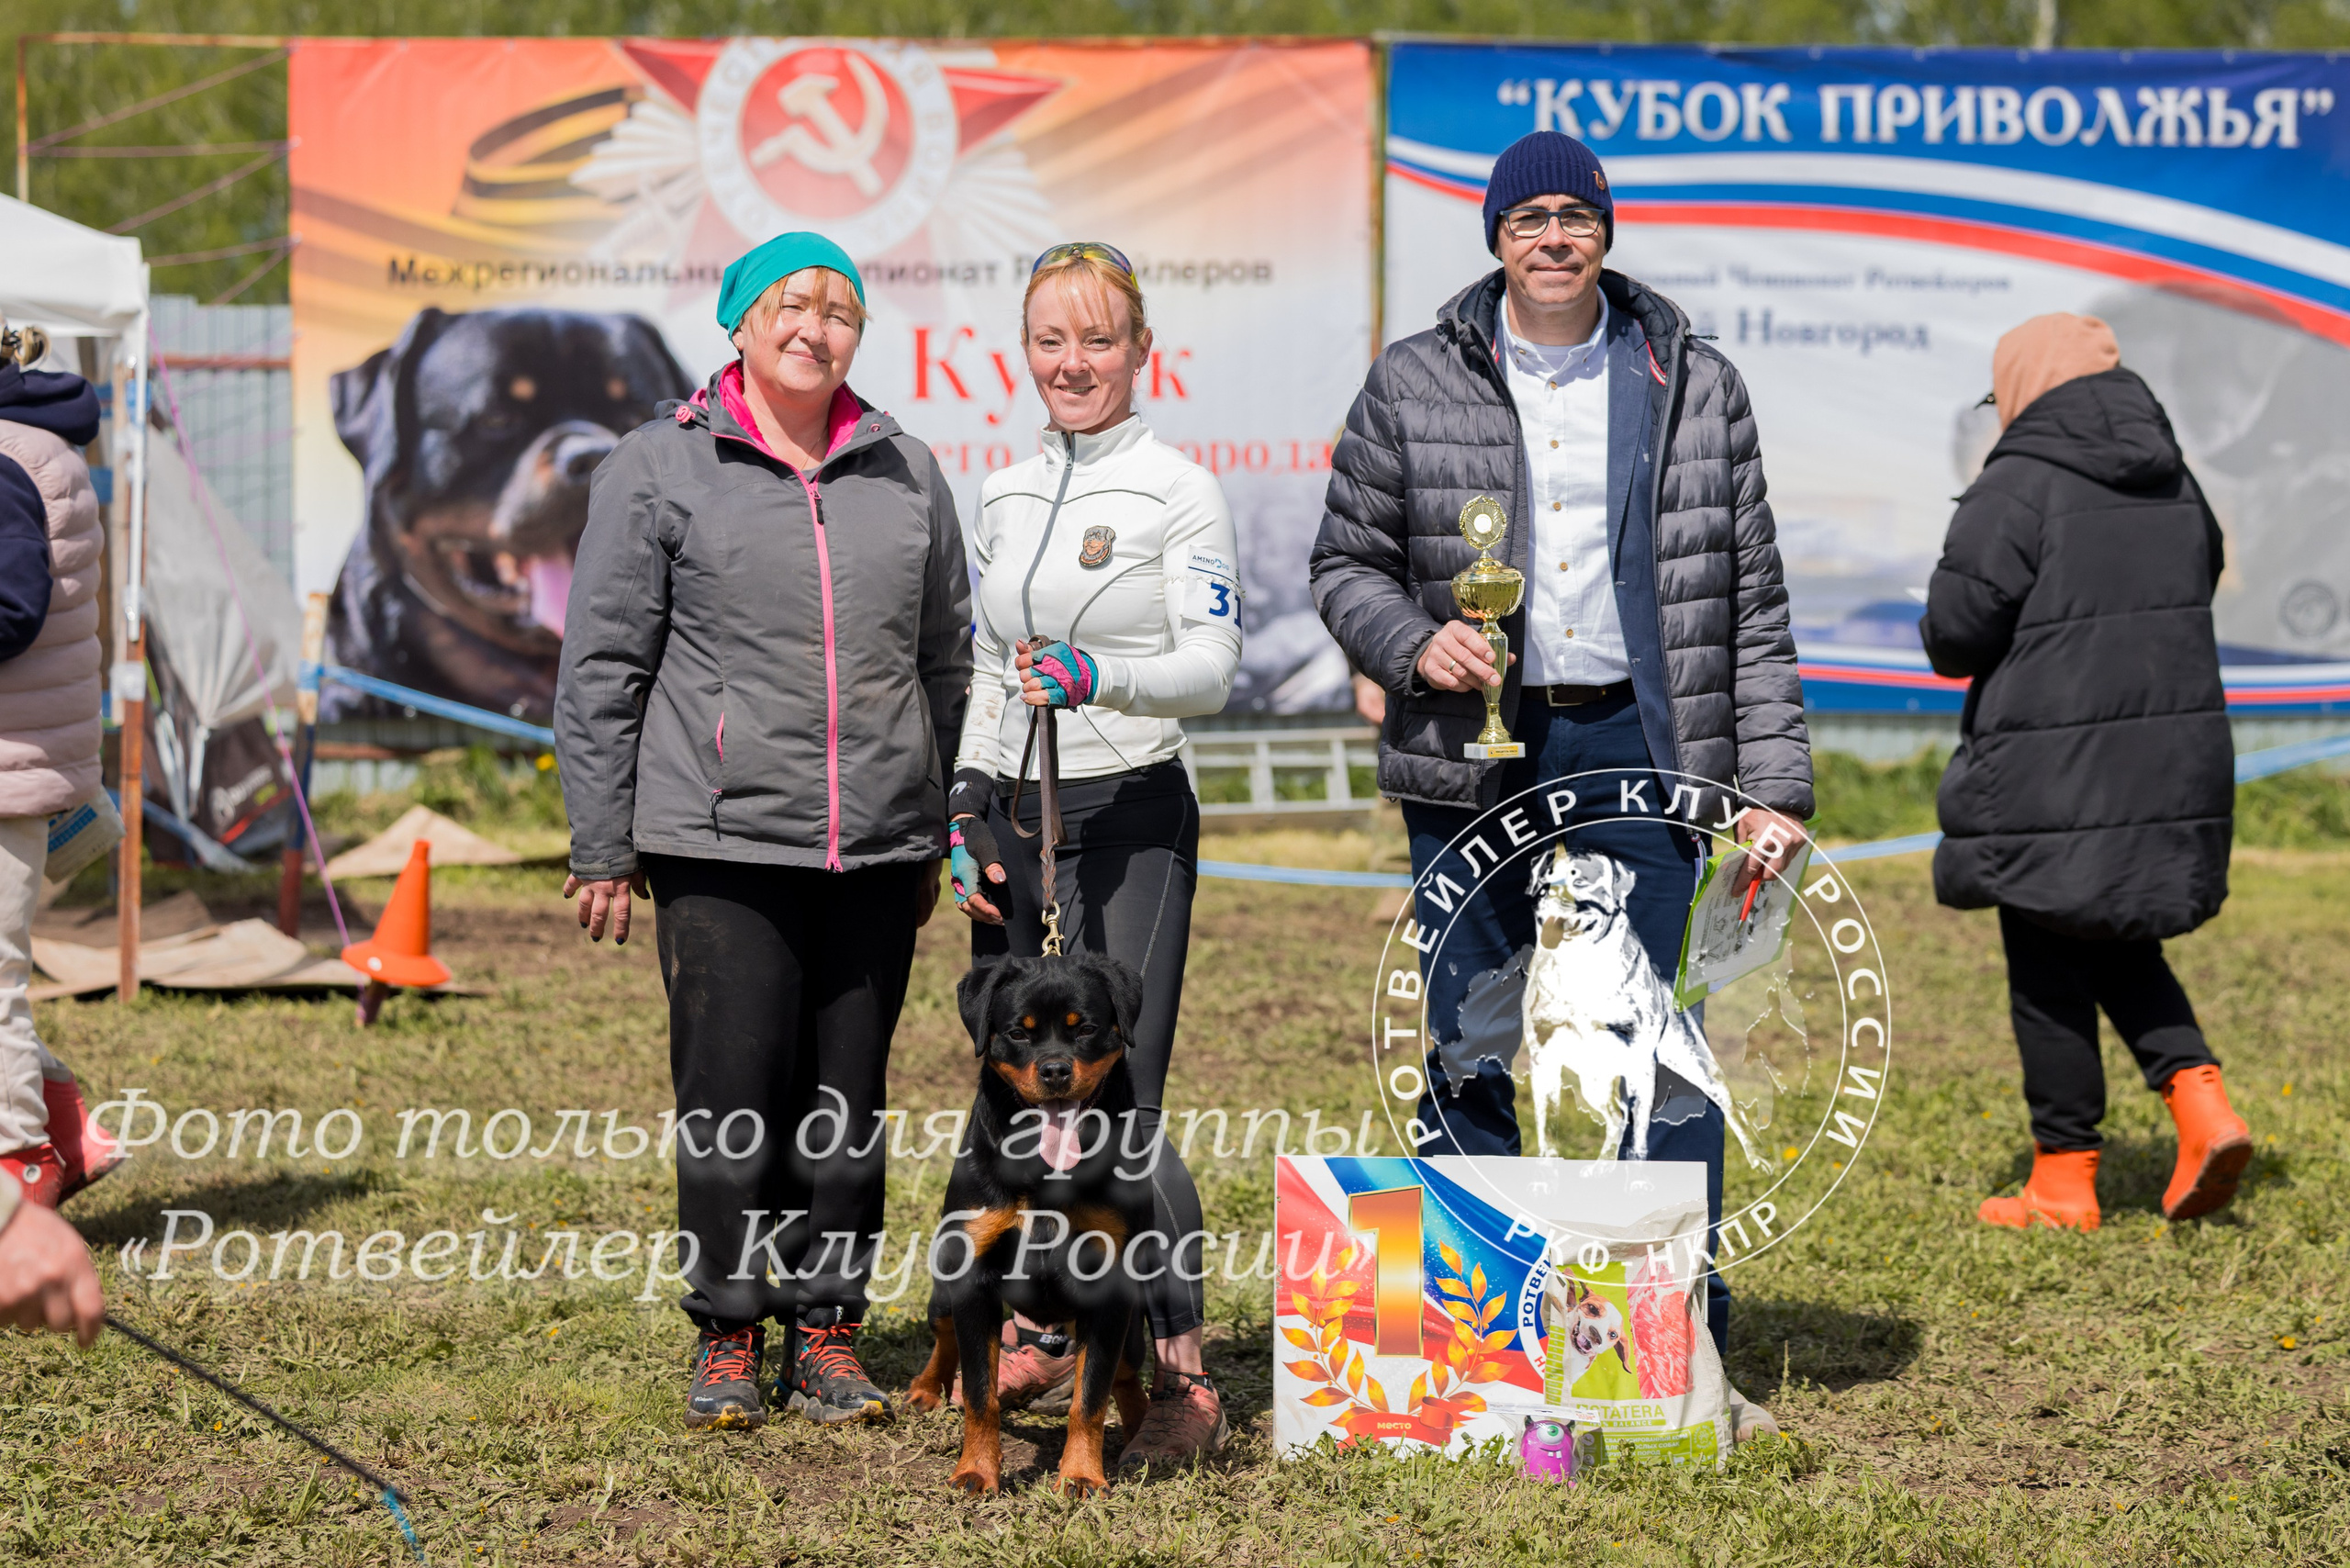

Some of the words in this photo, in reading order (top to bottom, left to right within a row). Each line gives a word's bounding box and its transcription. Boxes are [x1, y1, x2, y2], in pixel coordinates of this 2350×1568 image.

[389, 257, 728, 291] Межрегиональны
[854, 258, 999, 286] пионат
[1013, 257, 1274, 292] Рйлеров
[1737, 308, 1932, 356] Новгород
[912, 325, 1192, 425] Кук
[1348, 1184, 1424, 1358] 1
[1522, 1254, 1551, 1327] РОТВЕ
[1613, 1419, 1652, 1428] BALANCE
